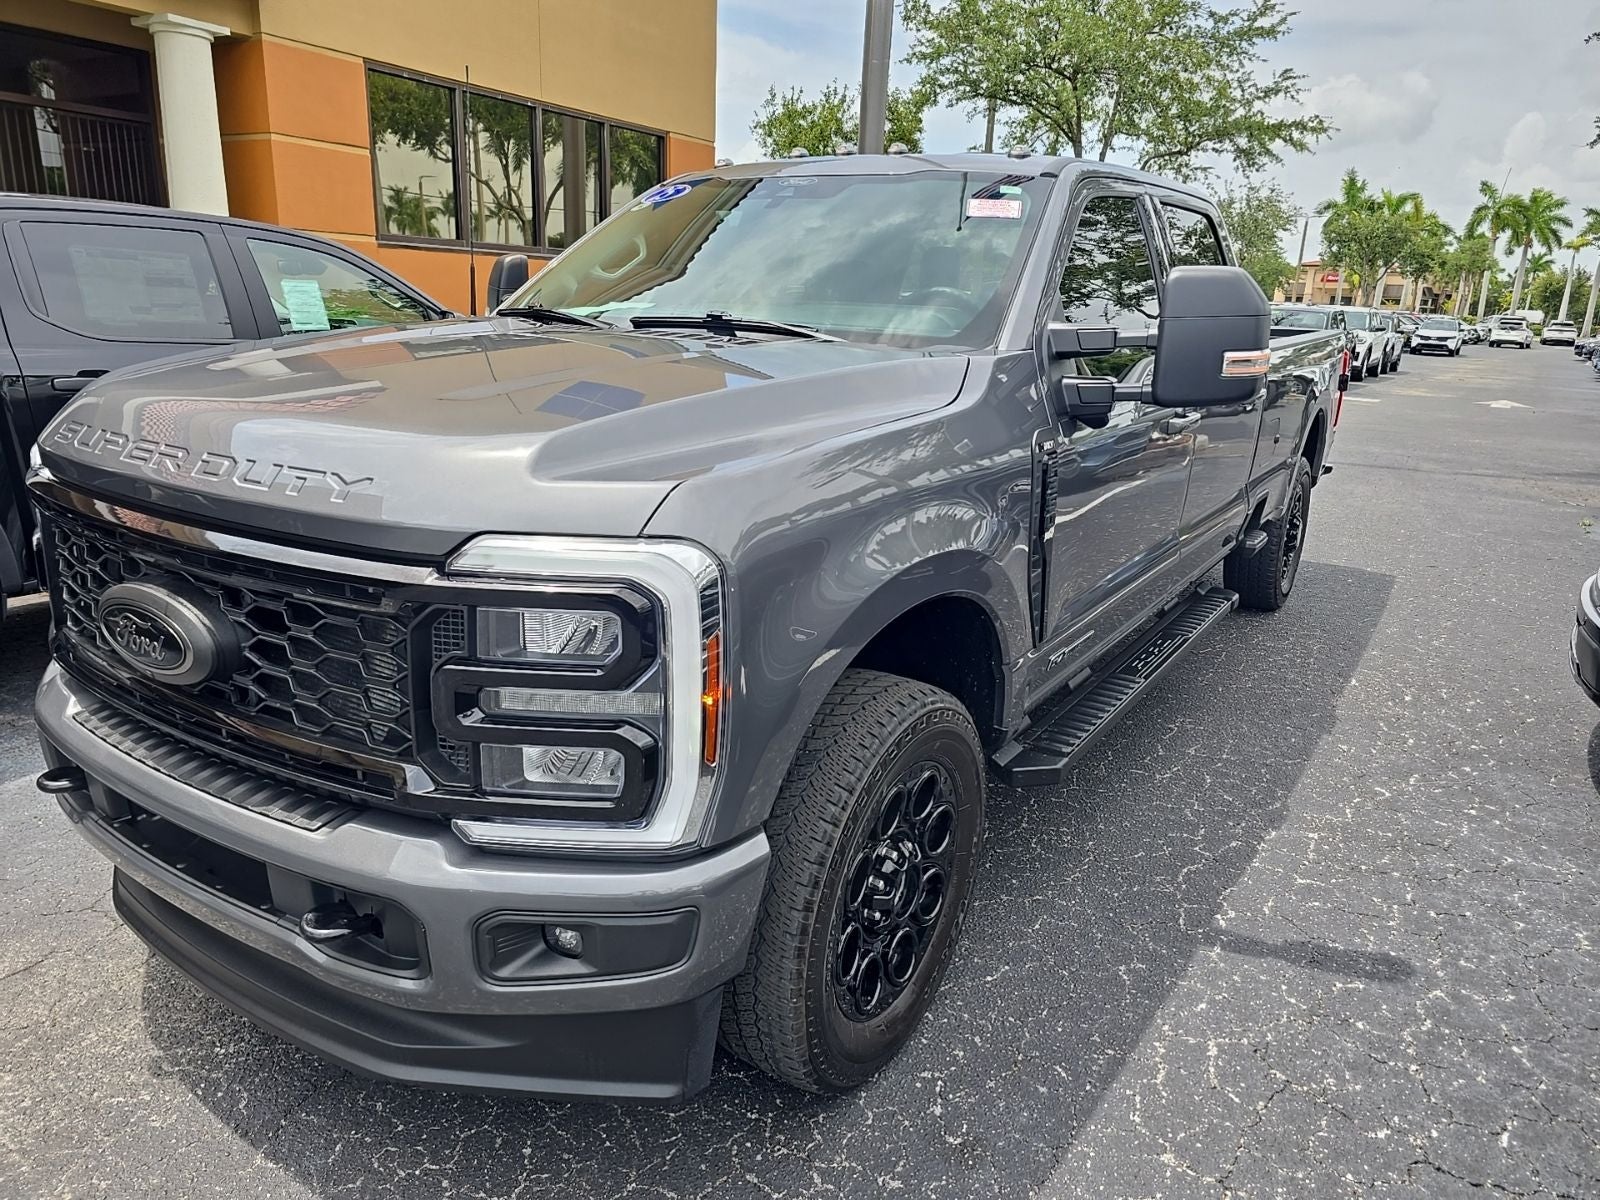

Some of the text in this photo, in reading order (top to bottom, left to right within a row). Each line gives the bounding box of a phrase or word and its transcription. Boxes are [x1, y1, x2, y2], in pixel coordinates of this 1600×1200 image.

[54, 420, 375, 504] SUPER DUTY
[104, 612, 166, 661] Ford
